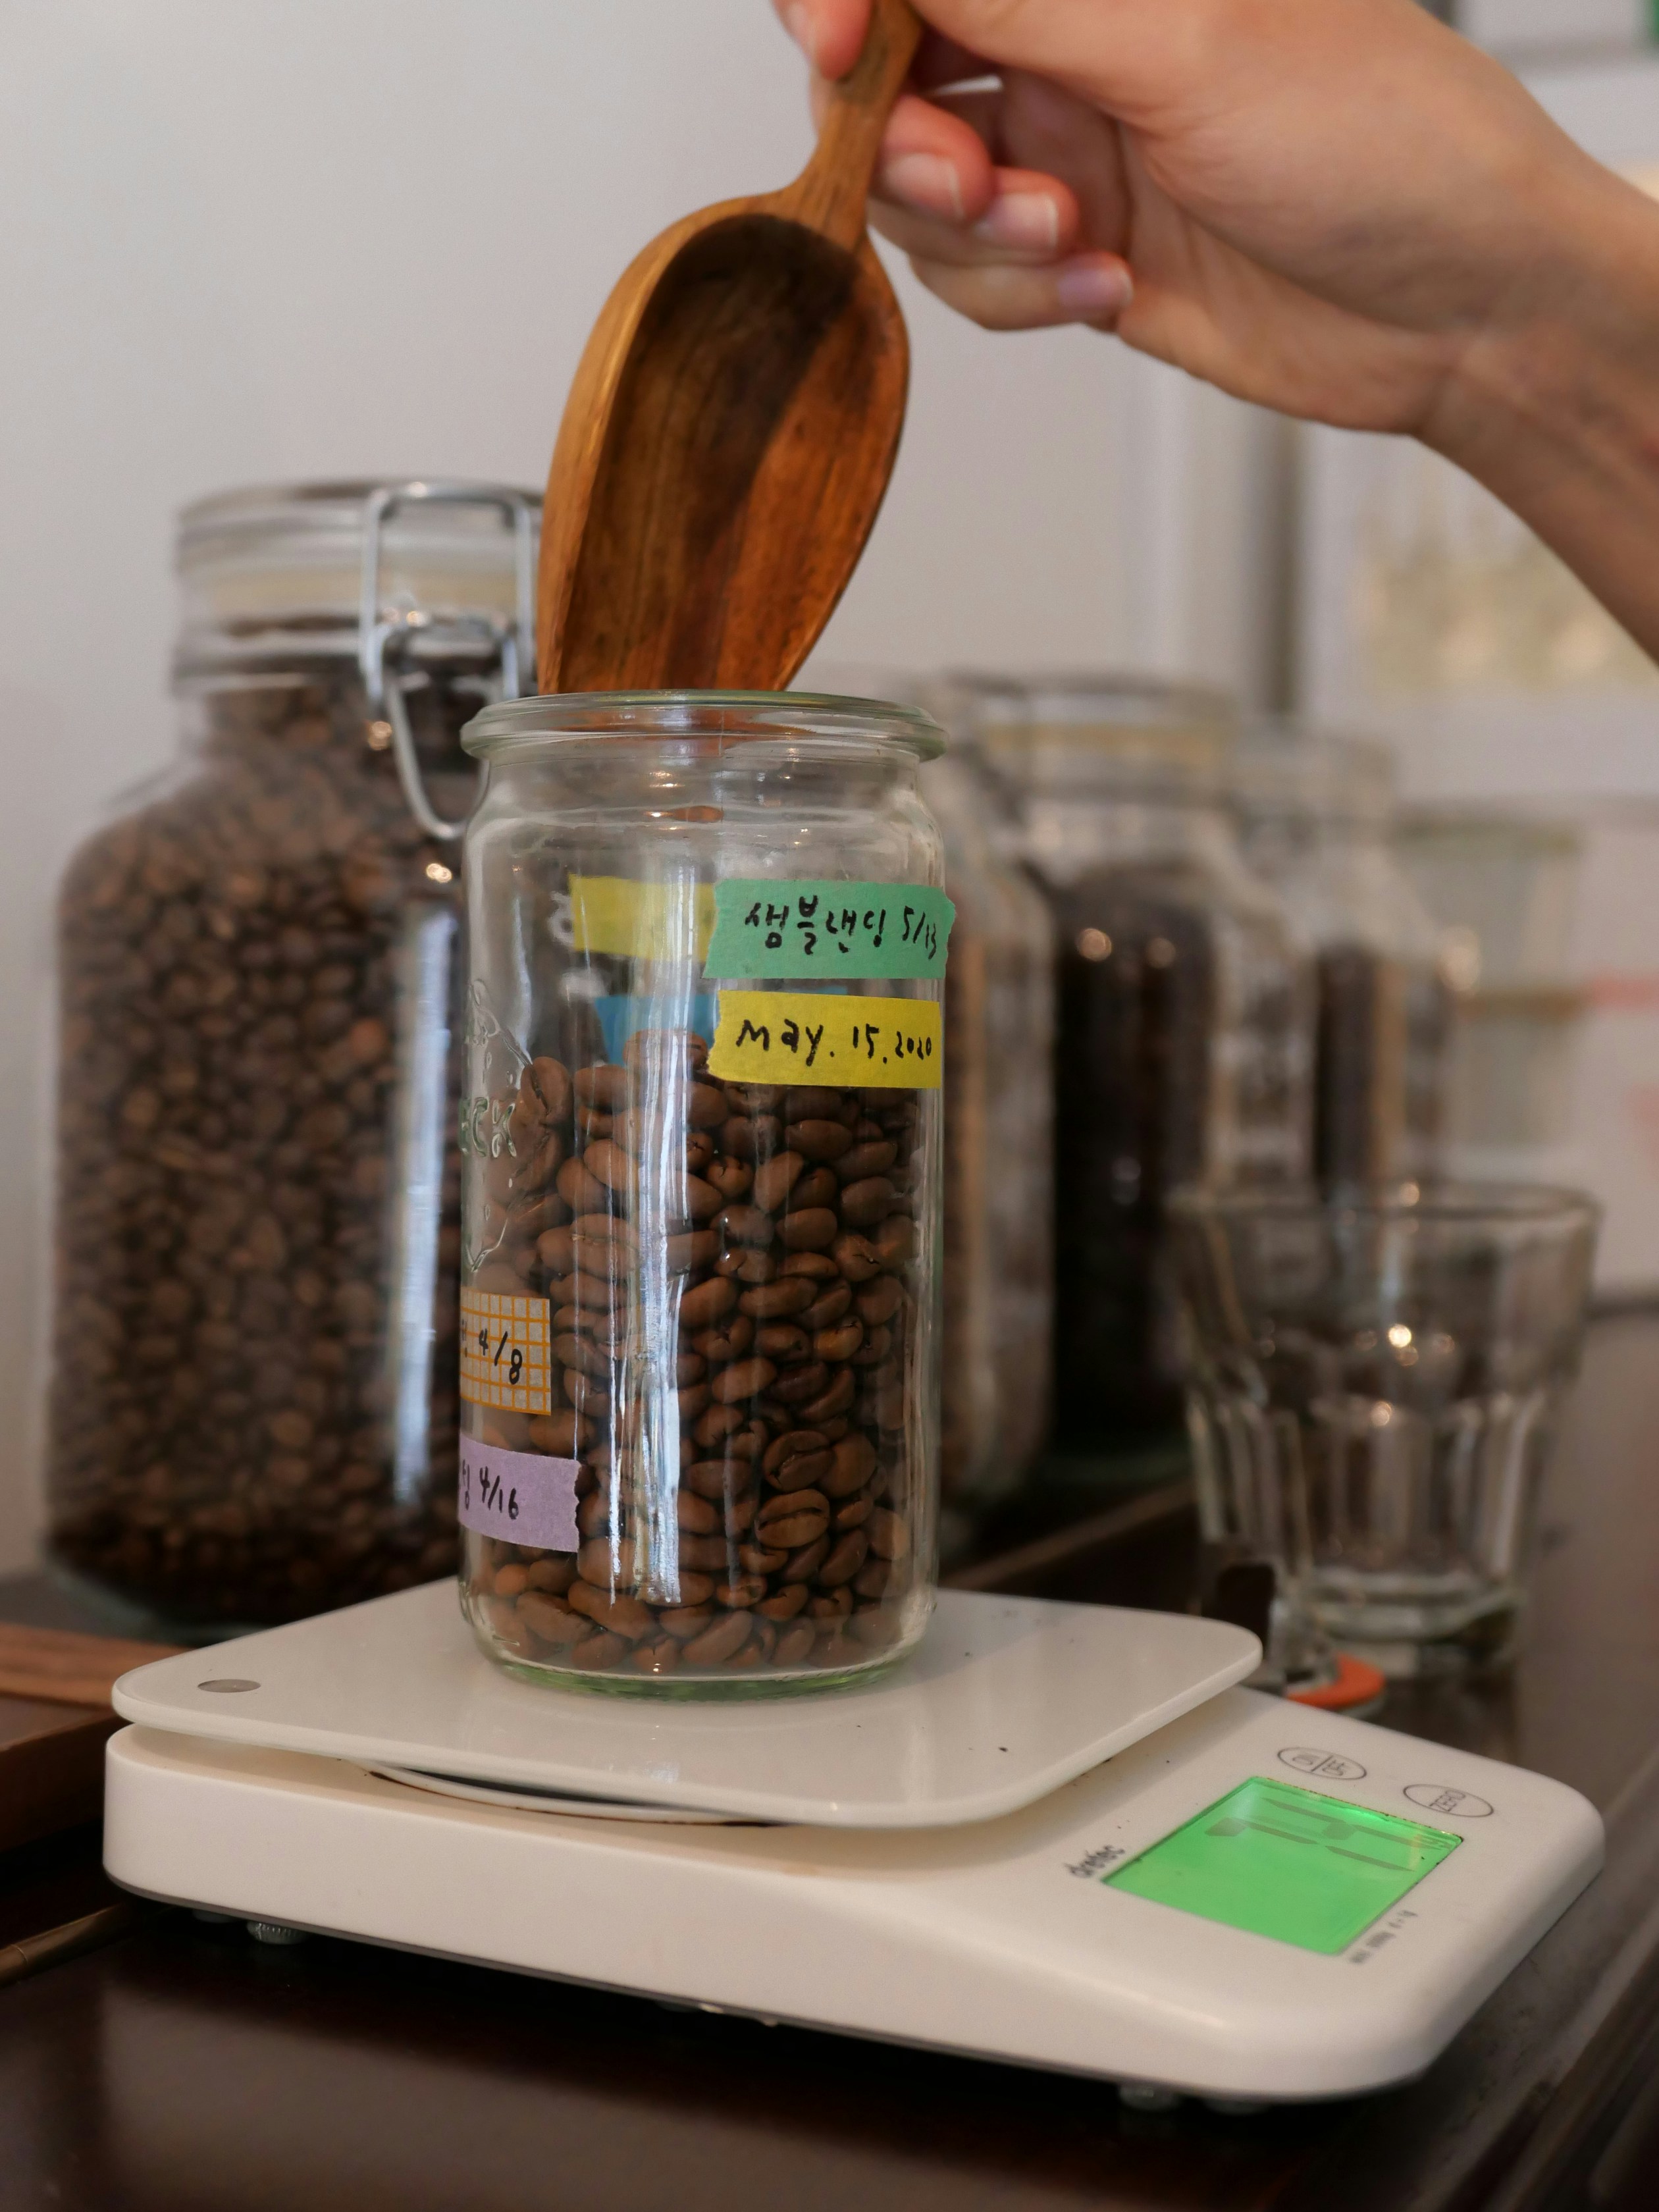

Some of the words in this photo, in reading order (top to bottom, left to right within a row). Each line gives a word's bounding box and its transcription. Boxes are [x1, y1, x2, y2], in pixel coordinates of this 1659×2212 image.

[902, 905, 937, 960] 5/13
[478, 1328, 523, 1385] 4/8
[479, 1465, 519, 1520] 4/16
